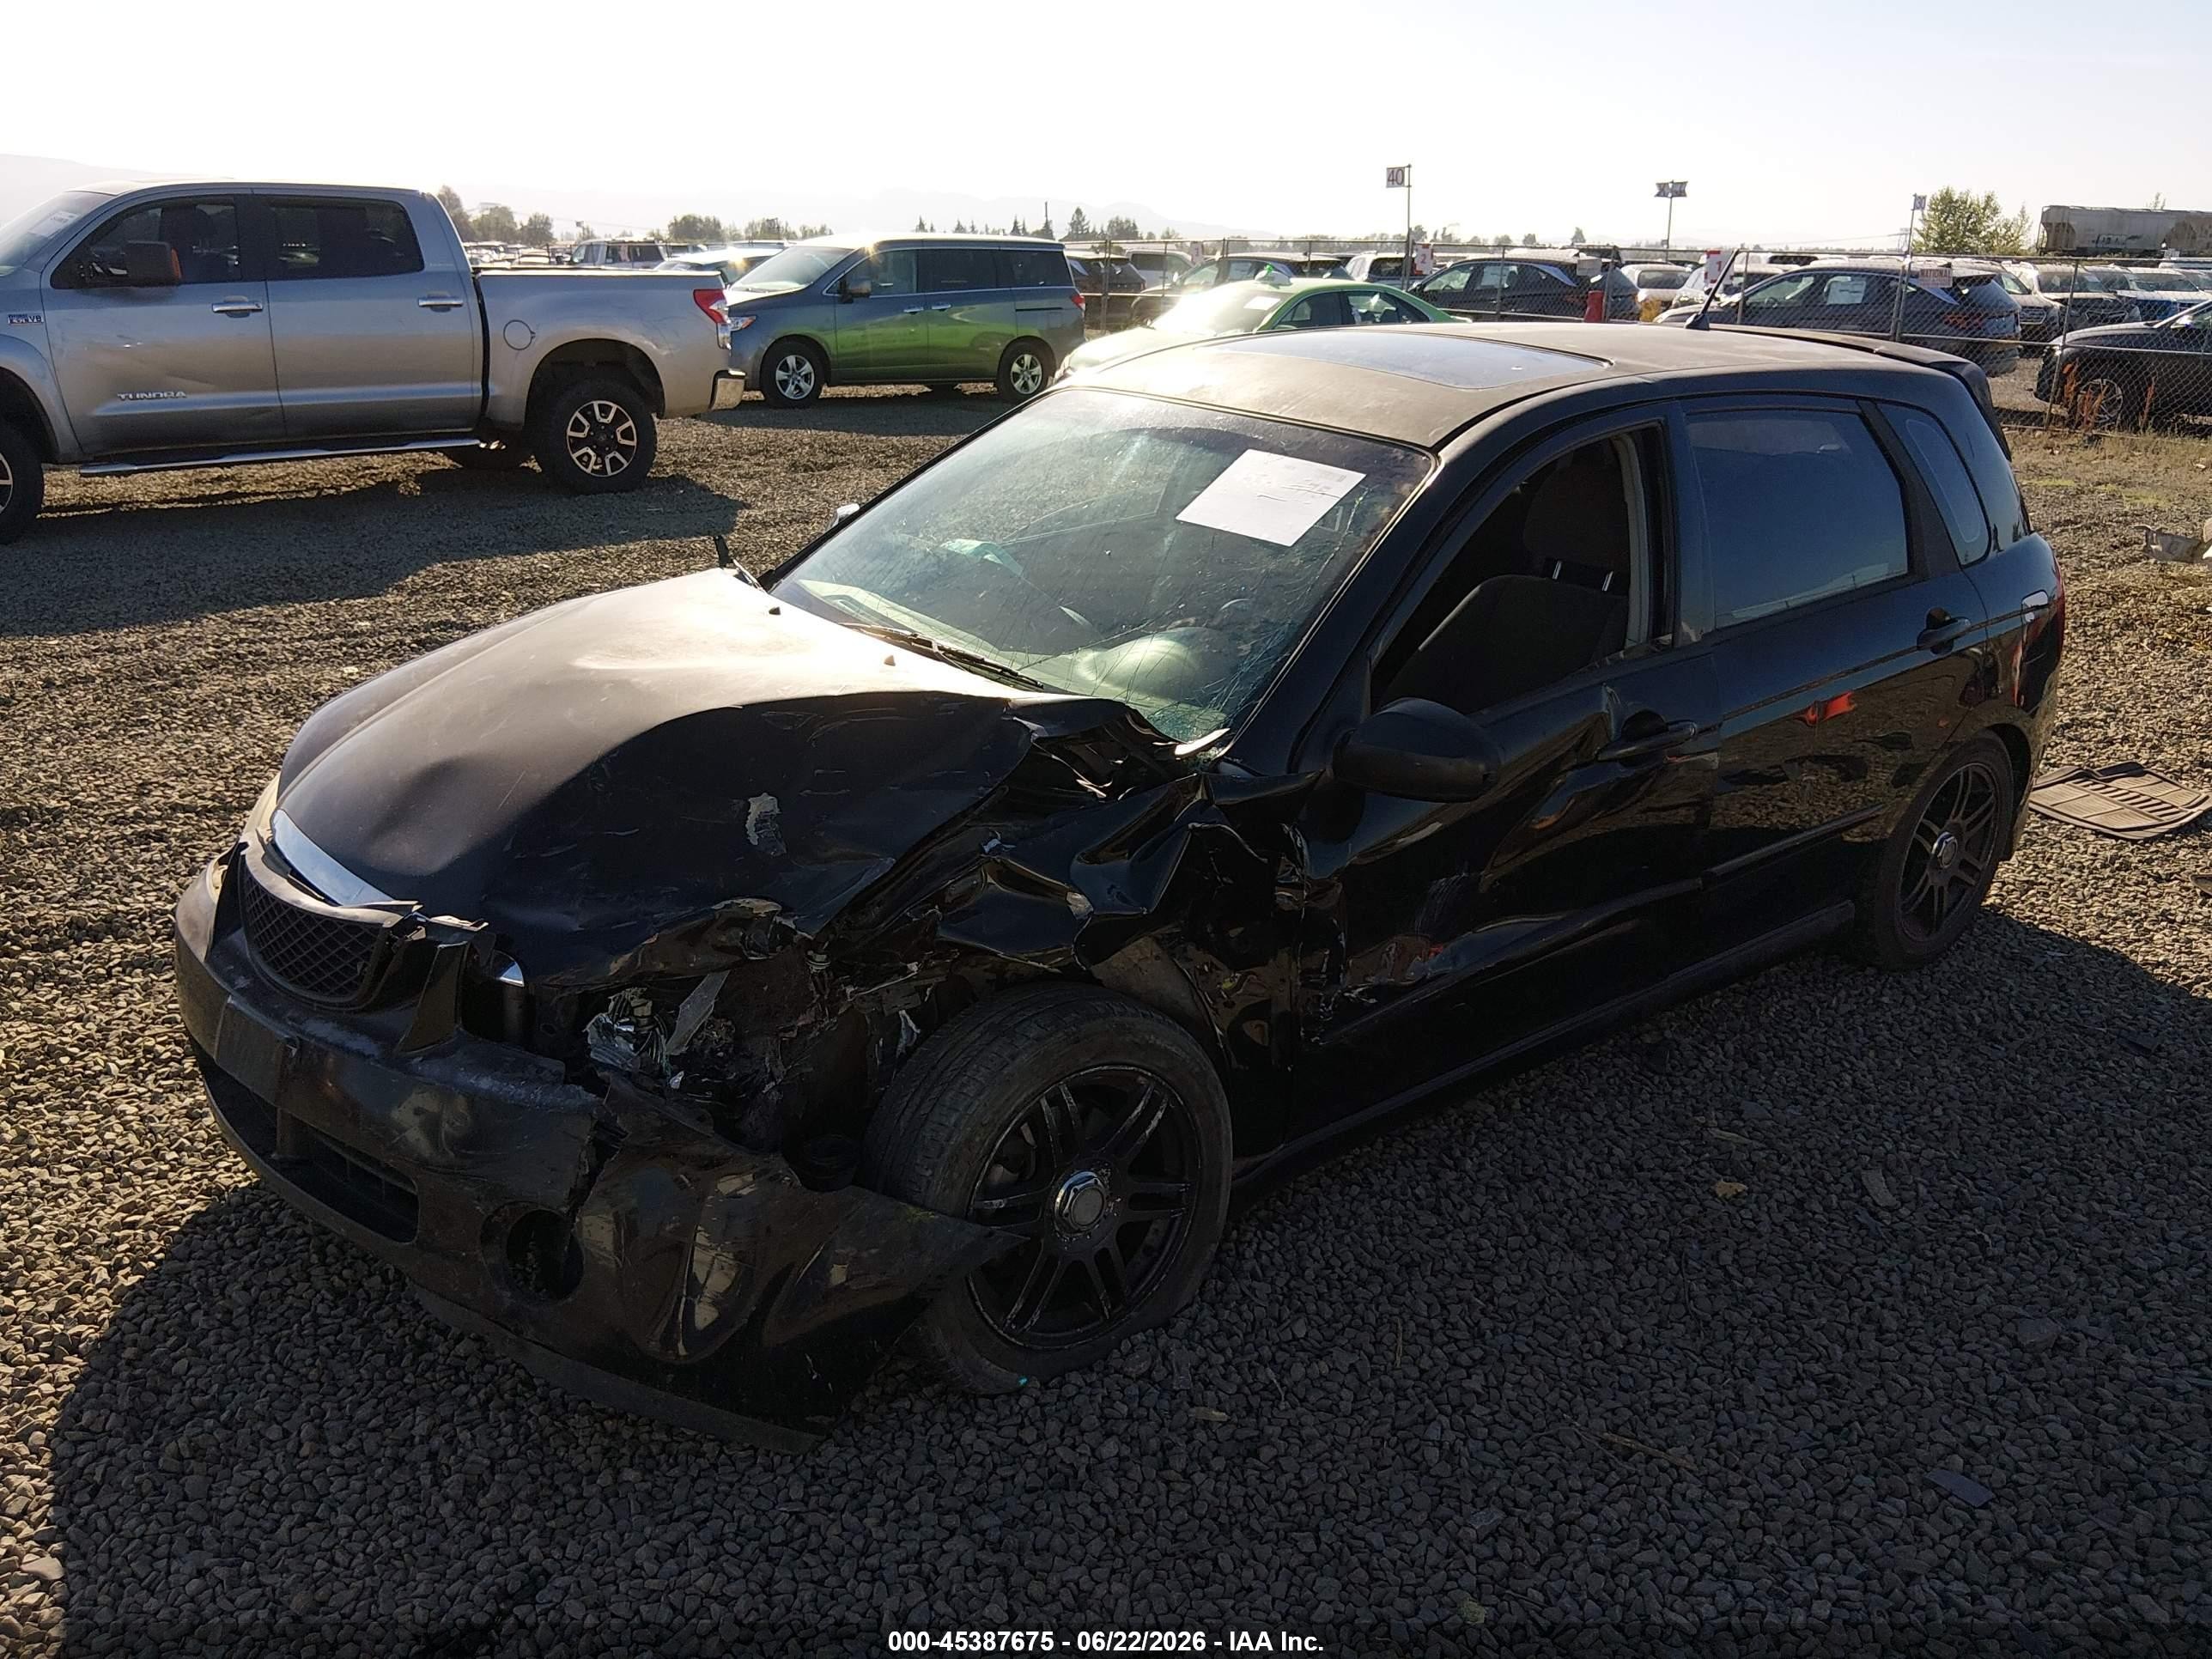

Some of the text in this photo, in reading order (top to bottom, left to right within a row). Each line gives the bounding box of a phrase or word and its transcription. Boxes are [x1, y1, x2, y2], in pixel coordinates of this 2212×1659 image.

[1388, 168, 1405, 185] 40
[1420, 254, 1426, 264] 2
[1716, 260, 1722, 271] 1
[1920, 269, 1952, 278] NATIONAL
[117, 391, 187, 401] TUNDRA
